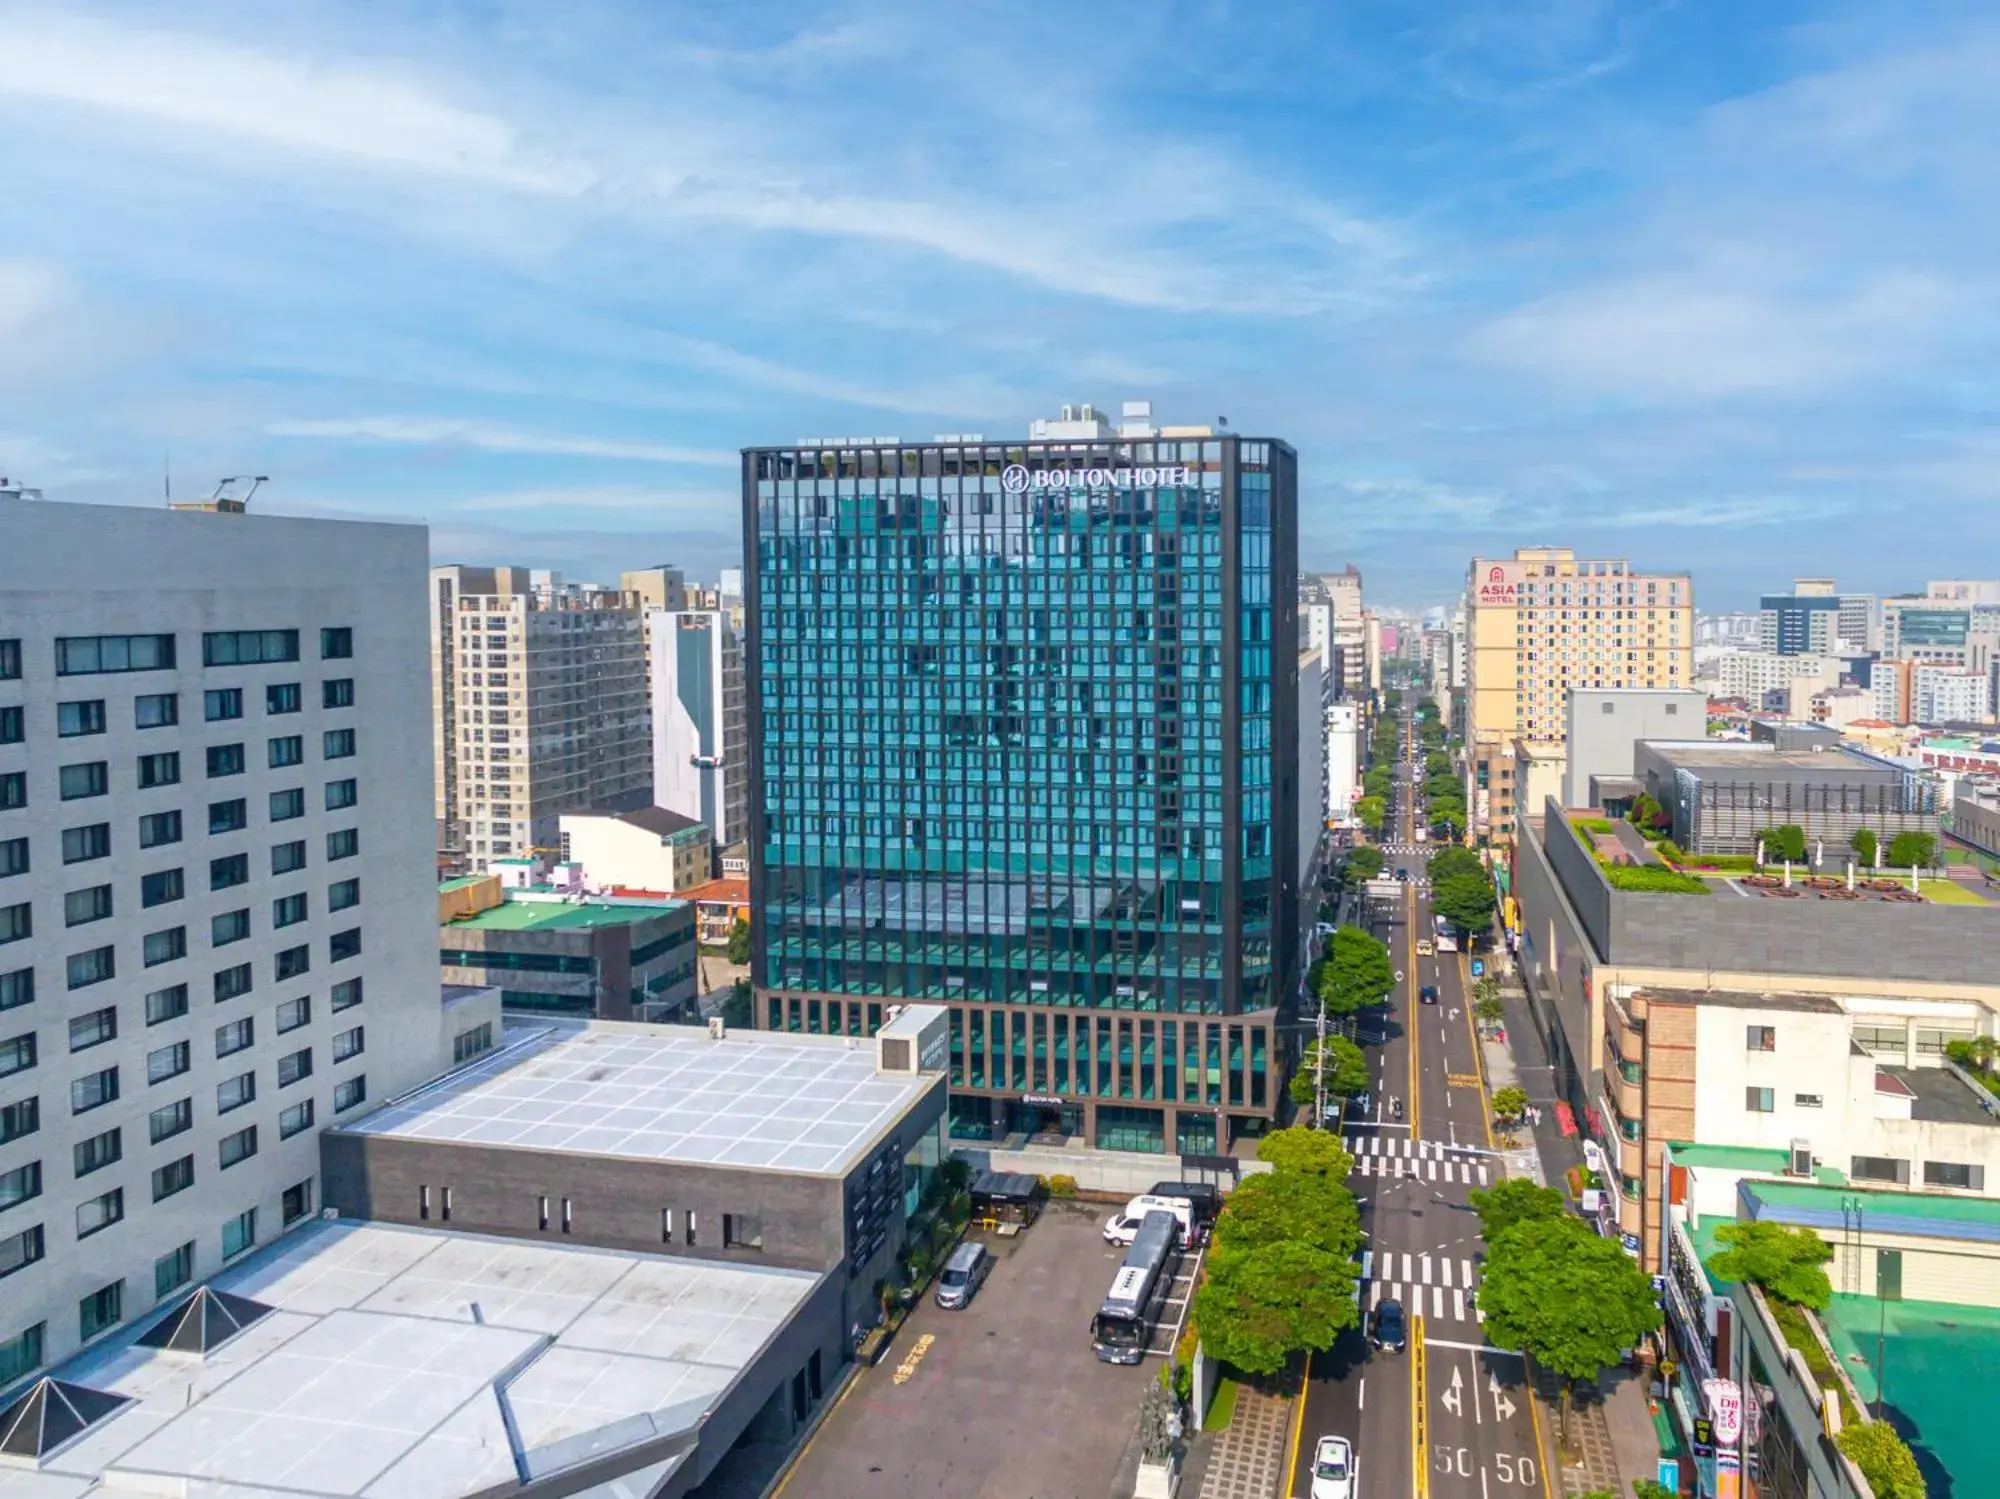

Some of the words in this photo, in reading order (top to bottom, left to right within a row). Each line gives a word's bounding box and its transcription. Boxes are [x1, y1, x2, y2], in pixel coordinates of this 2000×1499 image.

[1035, 469, 1118, 488] BOLTON
[1125, 467, 1192, 486] HOTEL
[1481, 585, 1515, 595] ASIA
[1434, 1445, 1475, 1478] 50
[1495, 1452, 1537, 1487] 50
